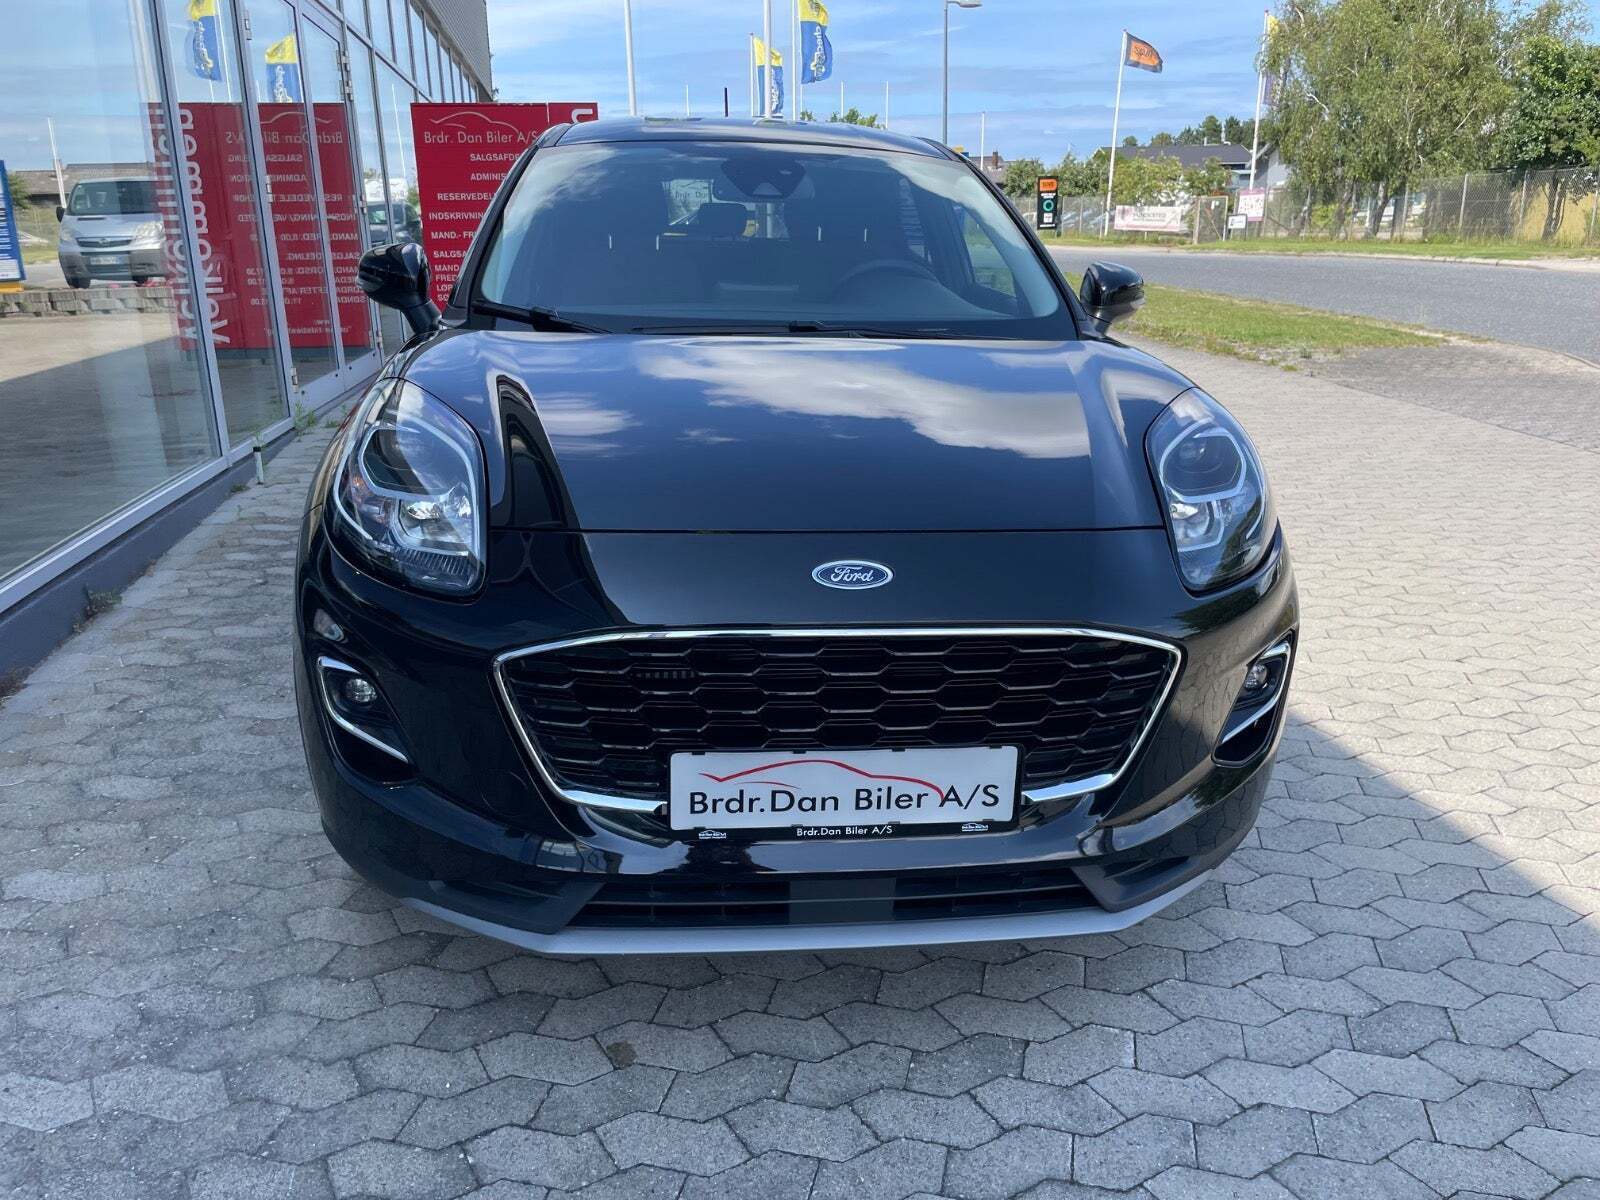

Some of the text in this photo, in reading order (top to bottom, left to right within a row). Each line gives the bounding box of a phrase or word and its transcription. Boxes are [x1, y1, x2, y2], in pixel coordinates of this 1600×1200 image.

[457, 131, 482, 143] Dan
[486, 130, 513, 143] Biler
[470, 153, 520, 162] SALGSAFDE
[470, 172, 507, 181] ADMINIS
[437, 193, 493, 201] RESERVEDEL
[429, 212, 483, 220] INDSKRIVNIN
[463, 231, 475, 239] FR
[433, 250, 467, 258] SALGSA
[435, 274, 458, 282] FRED
[830, 566, 874, 582] Ford
[855, 786, 929, 811] Biler
[938, 783, 1000, 810] A/S
[845, 826, 868, 835] Biler
[872, 825, 893, 834] A/S
